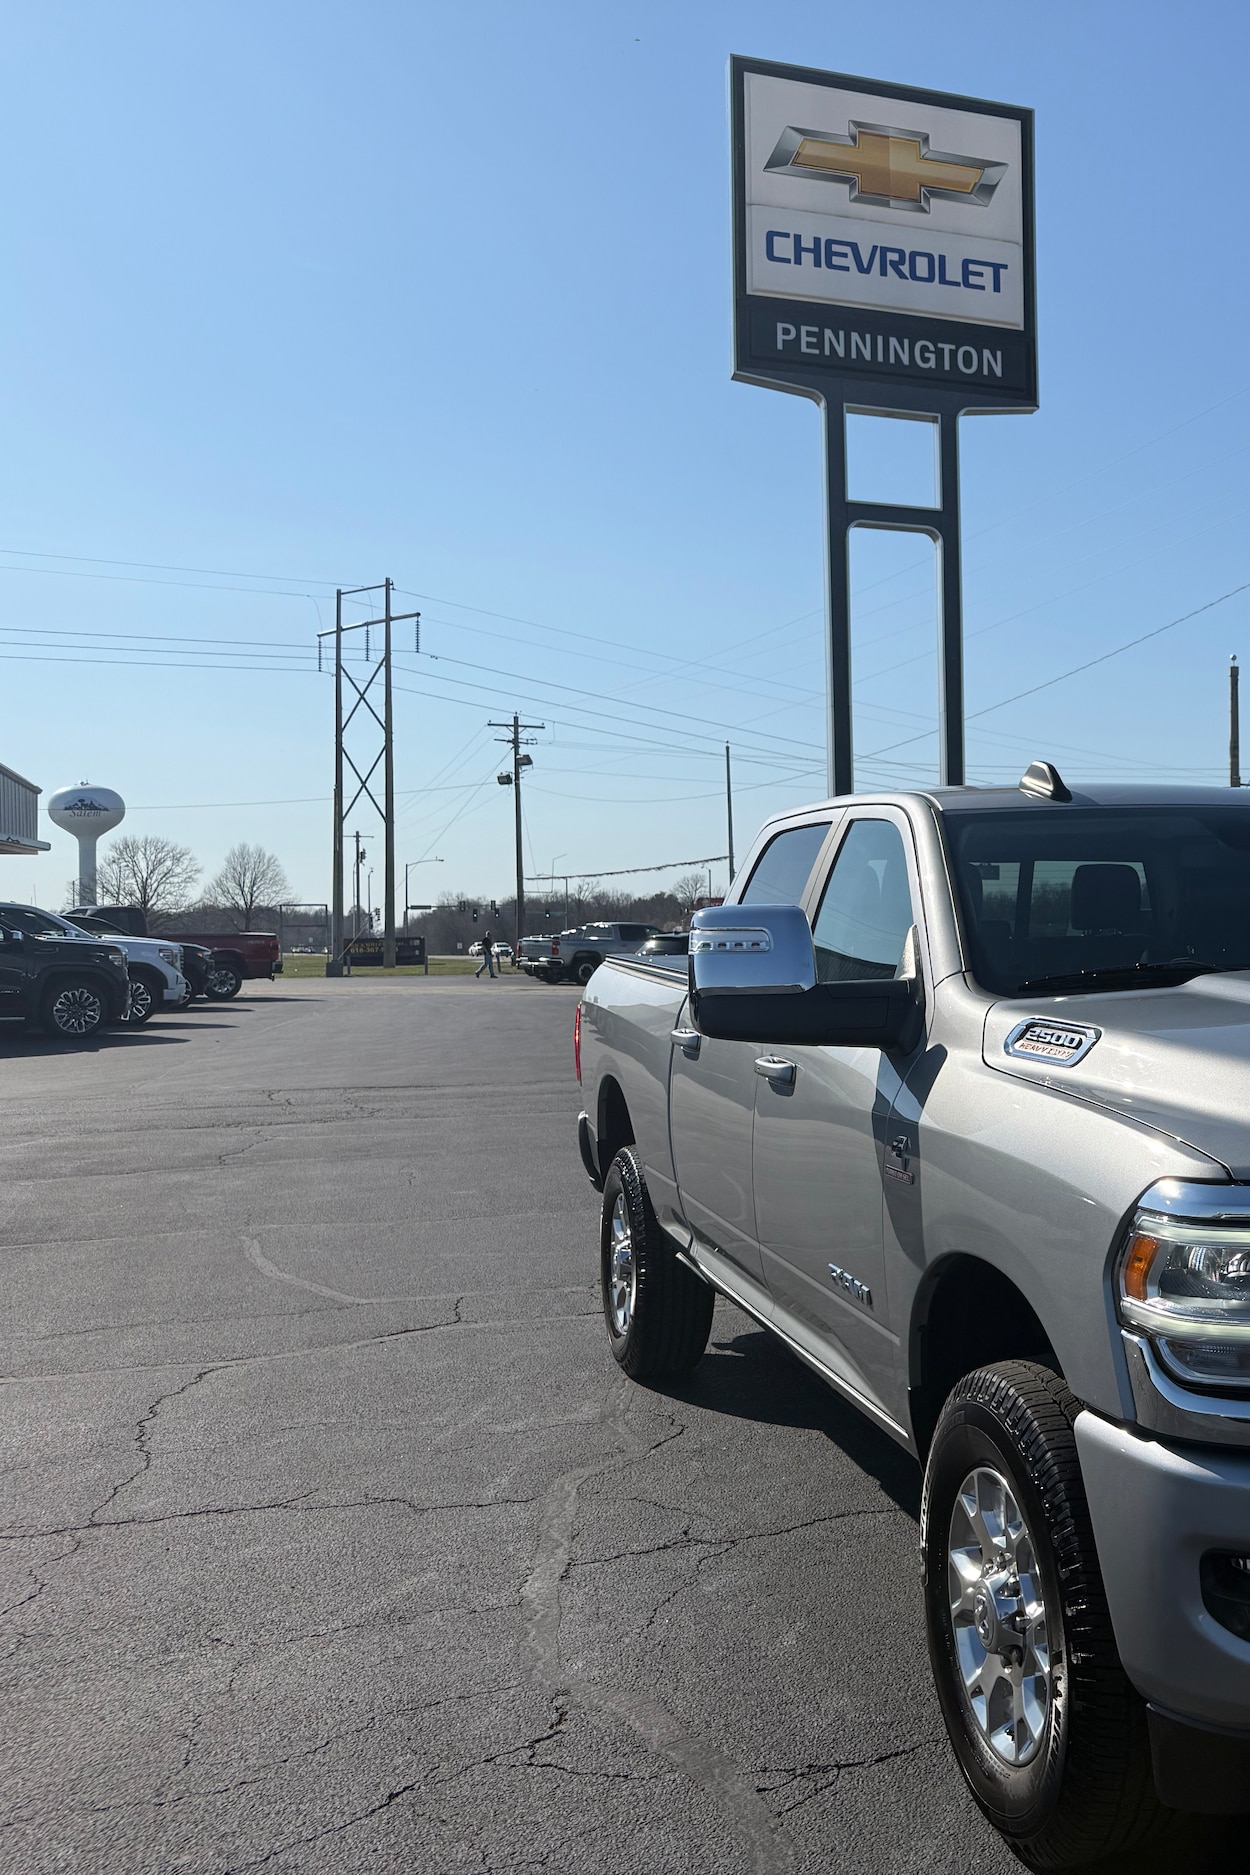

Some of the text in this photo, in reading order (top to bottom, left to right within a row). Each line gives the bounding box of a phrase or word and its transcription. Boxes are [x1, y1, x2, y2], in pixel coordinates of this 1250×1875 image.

[765, 230, 1009, 293] CHEVROLET
[775, 321, 1003, 378] PENNINGTON
[69, 810, 101, 818] Salem
[1019, 1042, 1048, 1053] HEAVY
[1025, 1028, 1081, 1048] 2500
